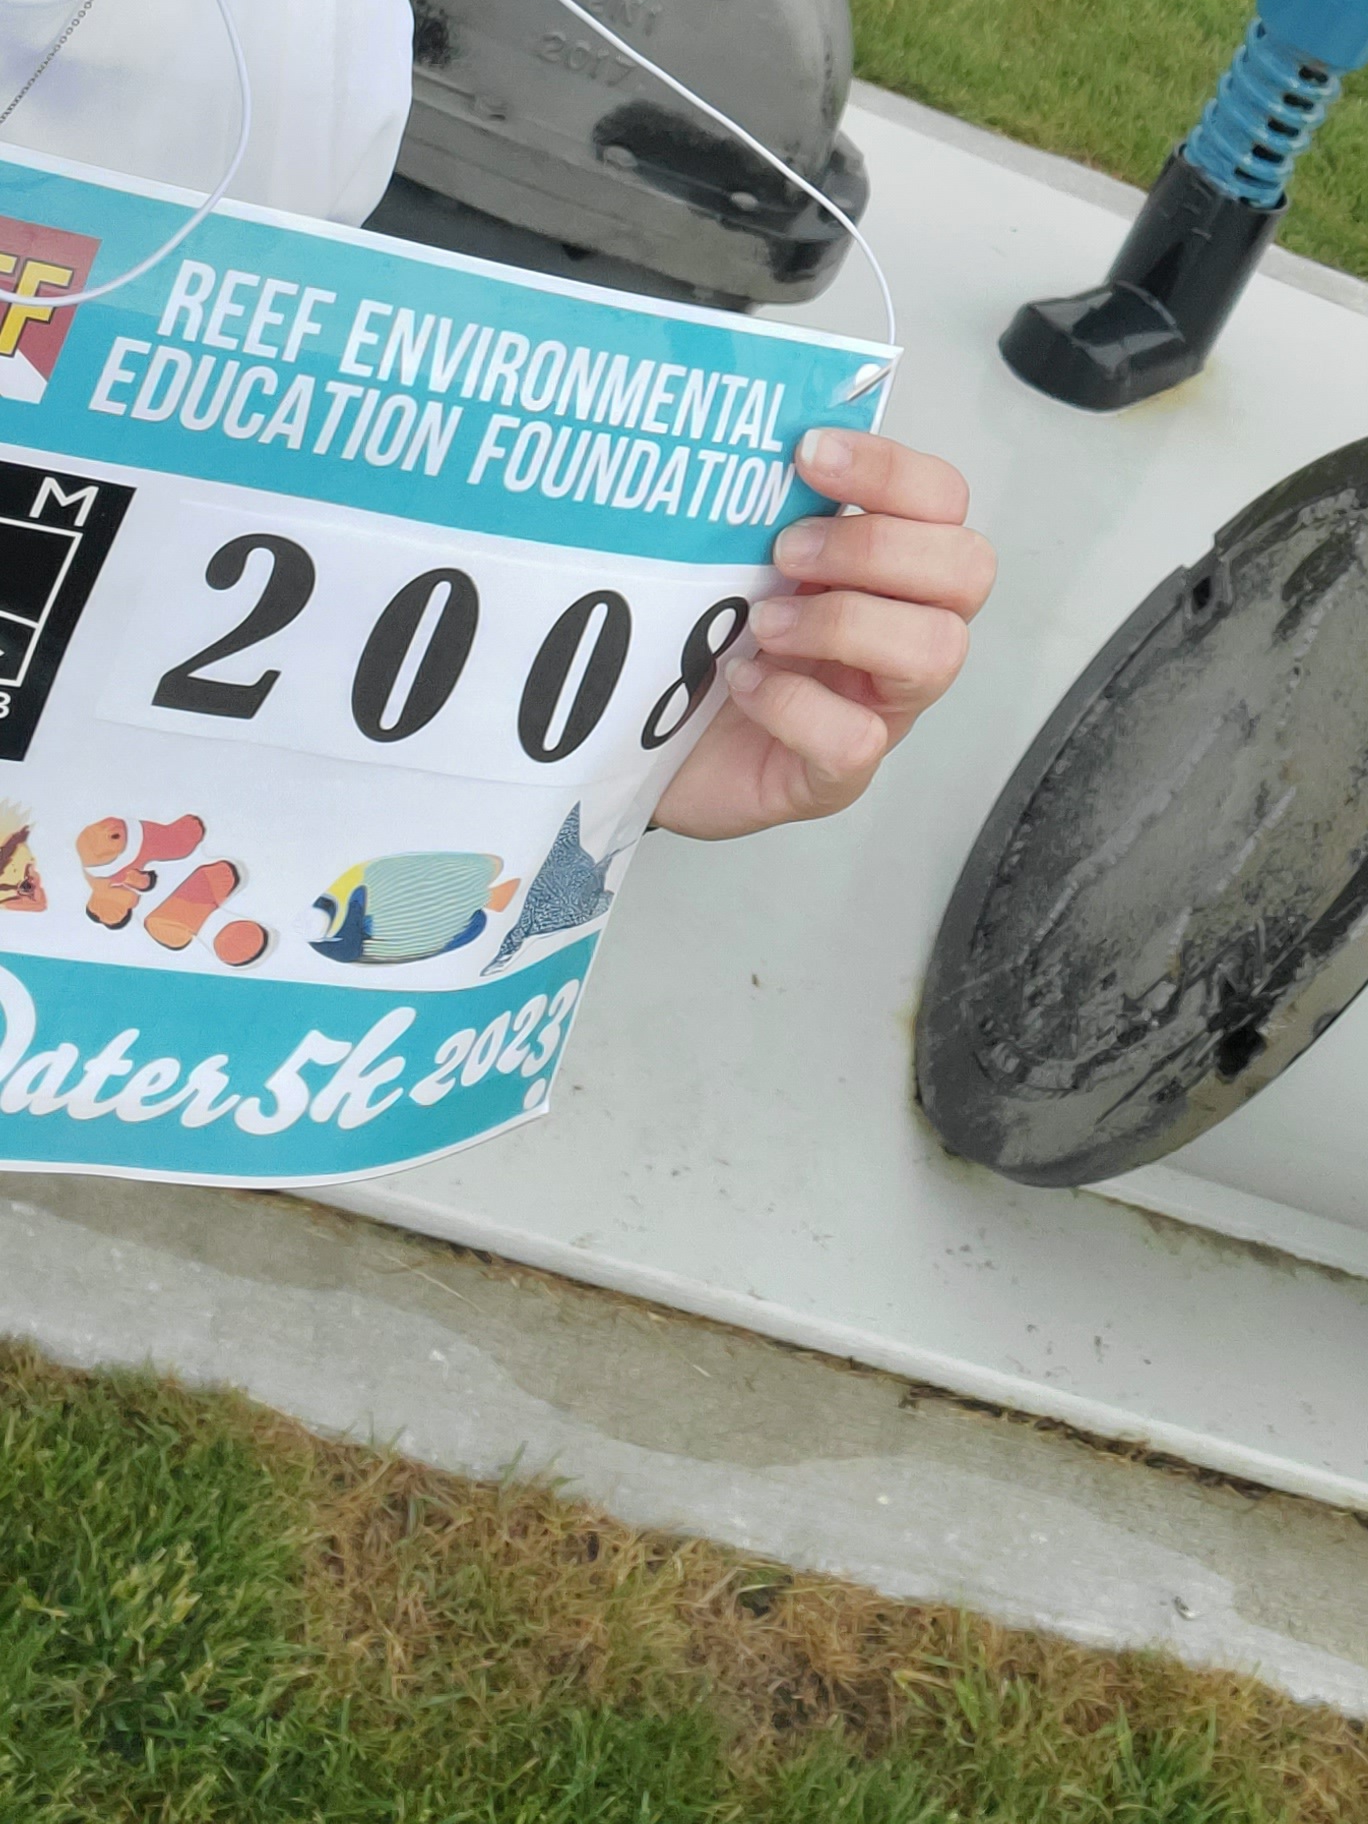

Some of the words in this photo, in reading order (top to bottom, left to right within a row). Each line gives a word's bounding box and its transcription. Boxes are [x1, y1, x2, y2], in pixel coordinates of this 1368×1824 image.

[89, 335, 466, 478] EDUCATION
[467, 414, 797, 528] FOUNDATION
[157, 259, 337, 367] REEF
[339, 299, 788, 453] ENVIRONMENTAL
[151, 532, 750, 764] 2008
